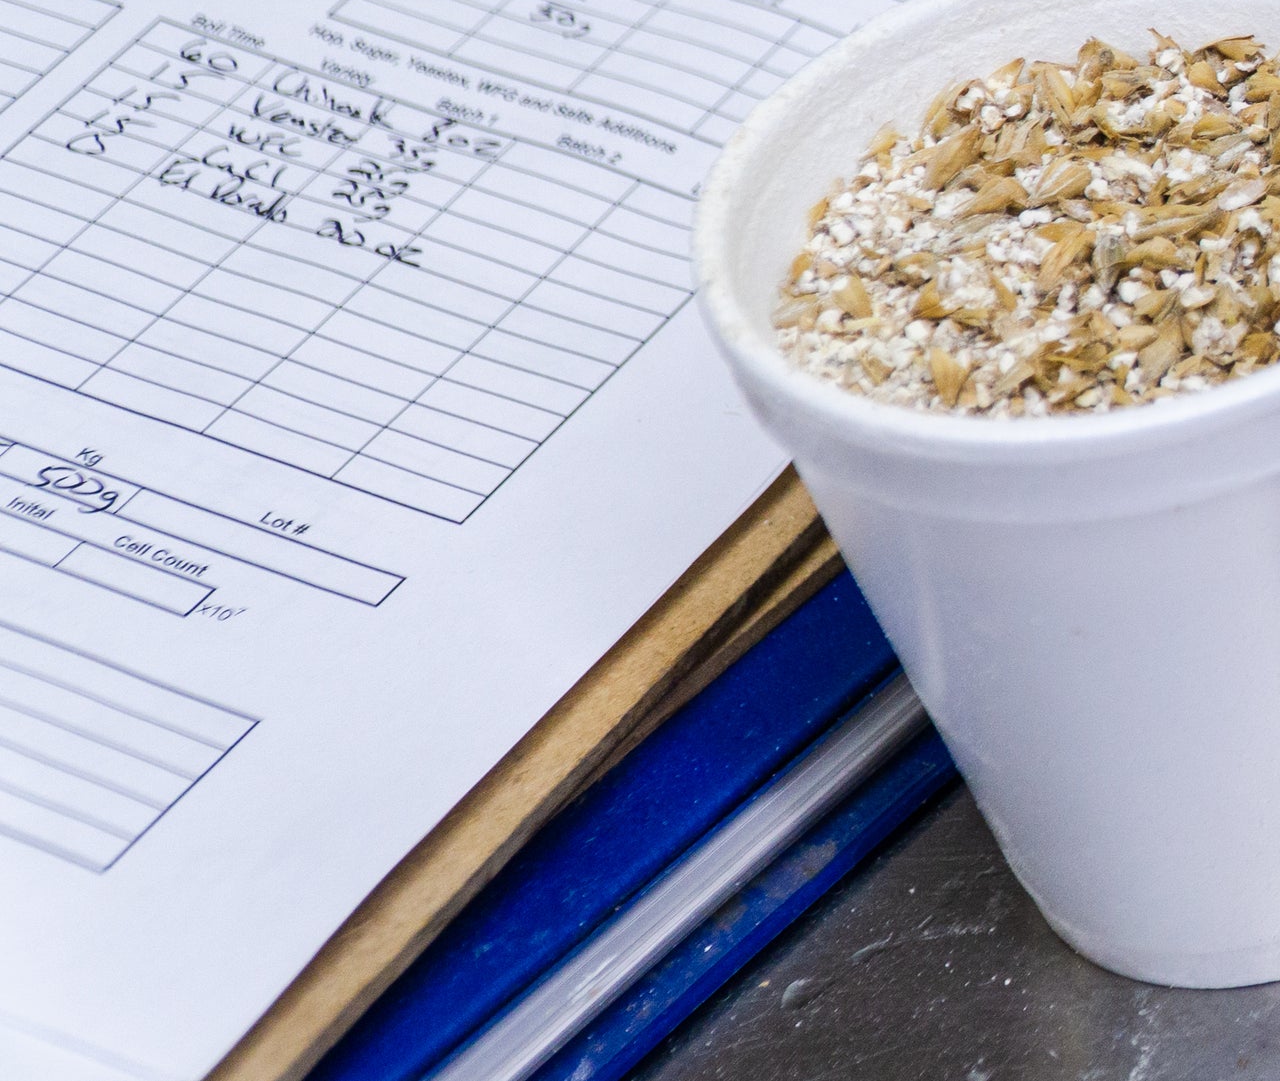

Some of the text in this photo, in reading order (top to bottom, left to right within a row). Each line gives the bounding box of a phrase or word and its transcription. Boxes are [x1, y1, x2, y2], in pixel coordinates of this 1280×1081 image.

[180, 38, 238, 72] 60
[75, 447, 104, 468] Kg
[7, 496, 56, 522] Inital
[259, 510, 294, 534] Lot
[113, 535, 209, 578] Cell Count
